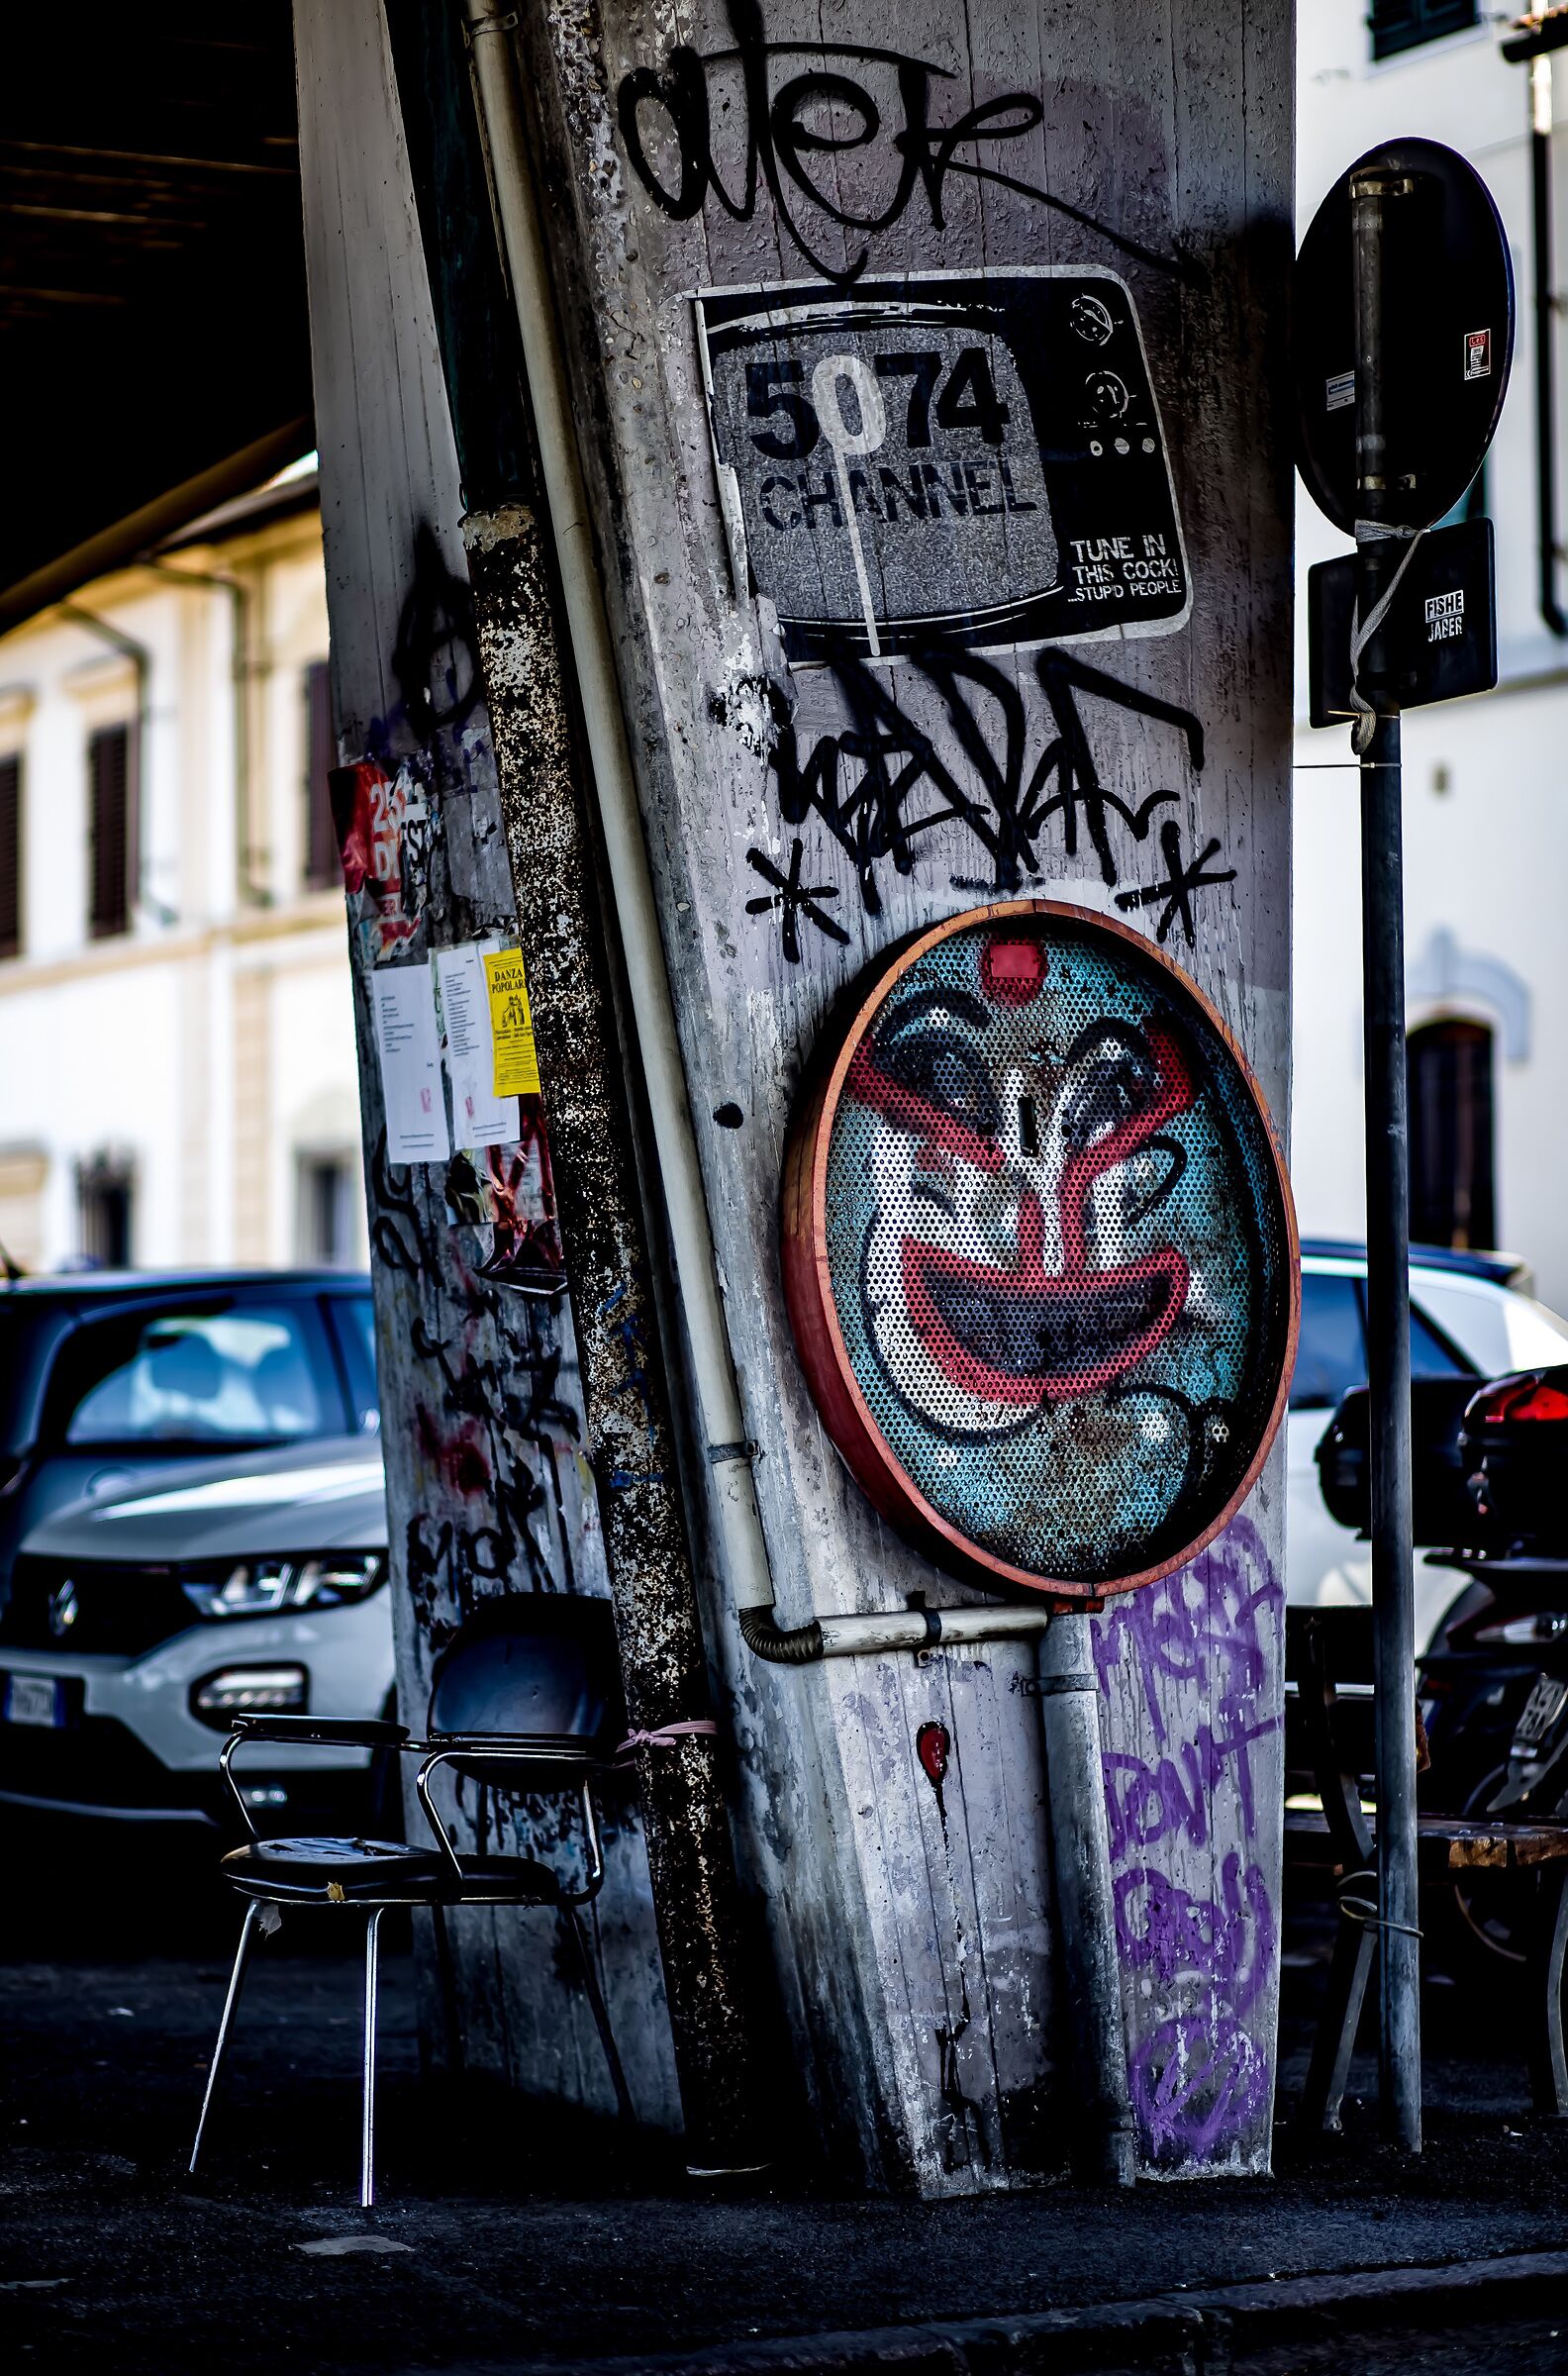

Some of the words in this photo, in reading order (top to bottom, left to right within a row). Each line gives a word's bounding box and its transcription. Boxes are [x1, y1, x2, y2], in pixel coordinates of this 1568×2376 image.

[744, 346, 1012, 459] 5074
[759, 458, 1037, 531] CHANNEL
[1069, 537, 1134, 562] TUNE
[1129, 579, 1182, 596] PEOPLE
[1426, 592, 1462, 619] FISHE
[494, 967, 524, 982] DANZA
